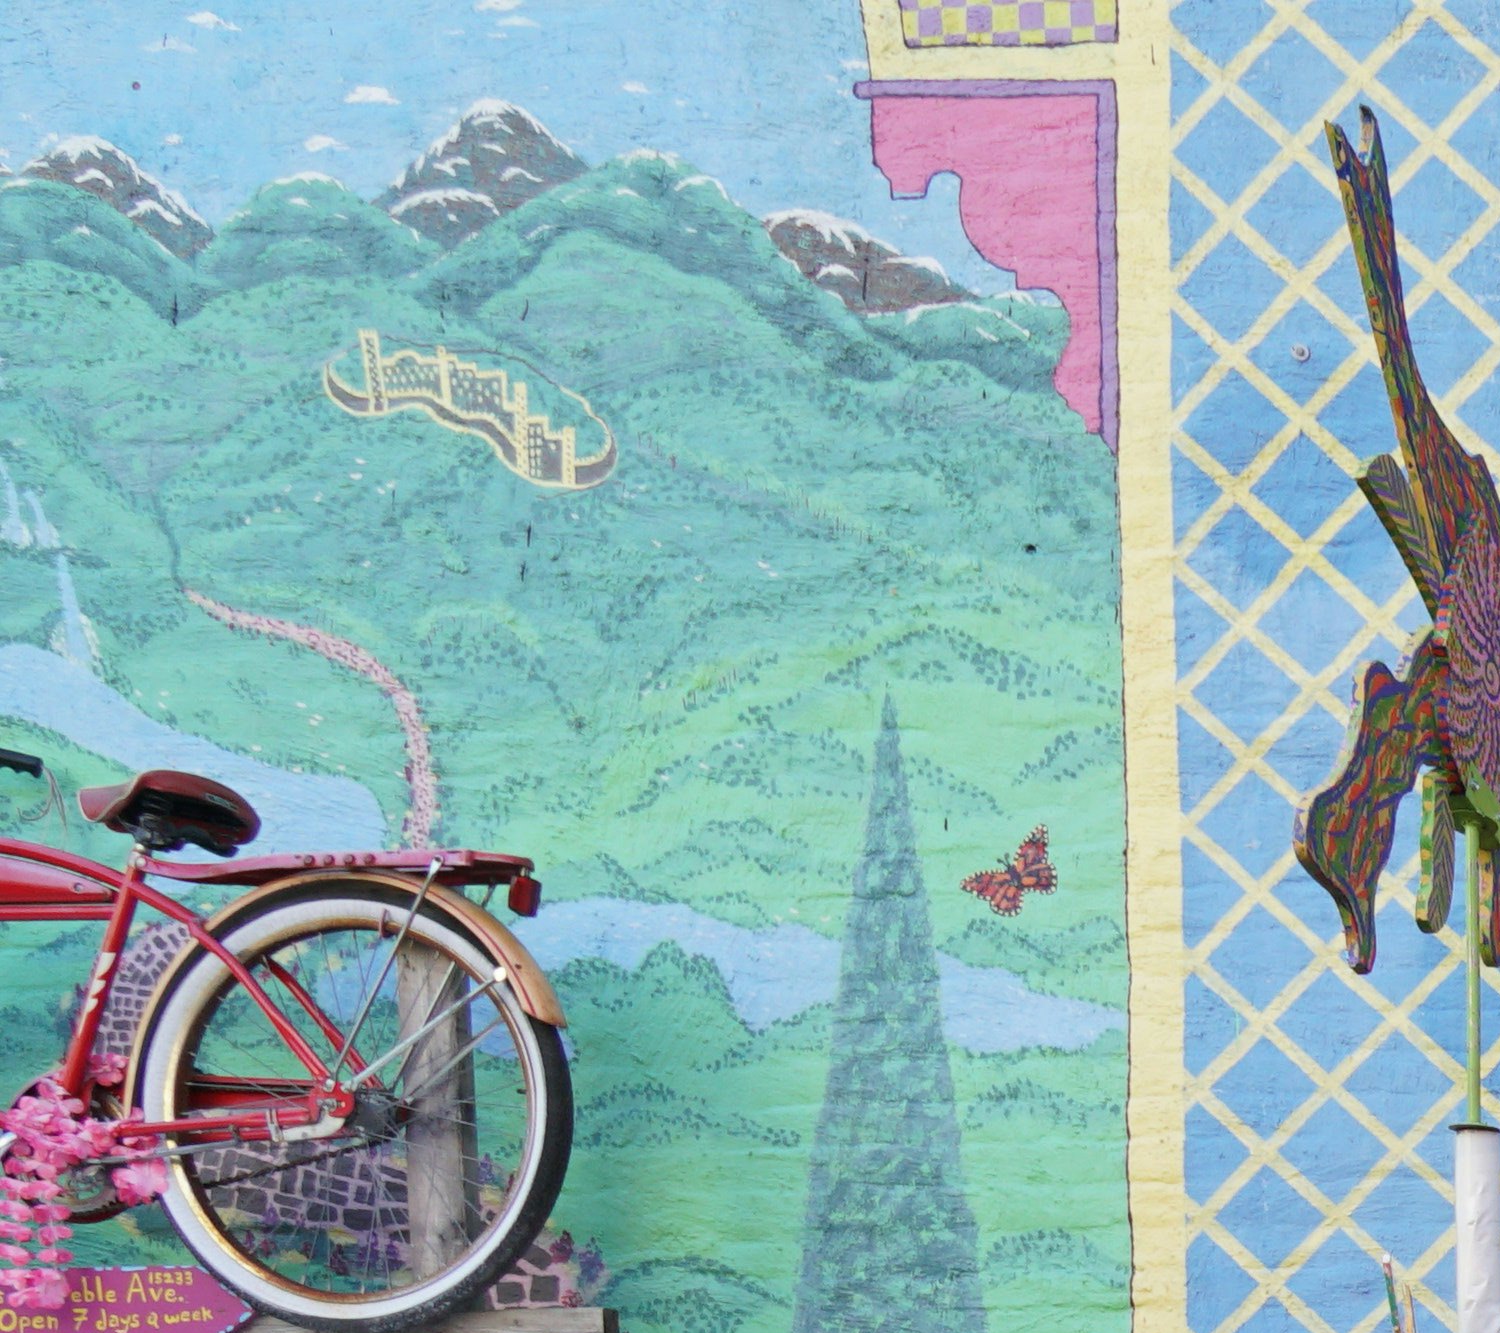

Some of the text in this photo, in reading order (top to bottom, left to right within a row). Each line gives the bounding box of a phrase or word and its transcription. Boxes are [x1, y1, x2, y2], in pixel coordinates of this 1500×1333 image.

[126, 1272, 185, 1304] Ave.
[148, 1271, 194, 1286] 15233
[72, 1308, 89, 1330] 7
[95, 1308, 141, 1333] days
[146, 1312, 160, 1329] a
[163, 1306, 214, 1325] week
